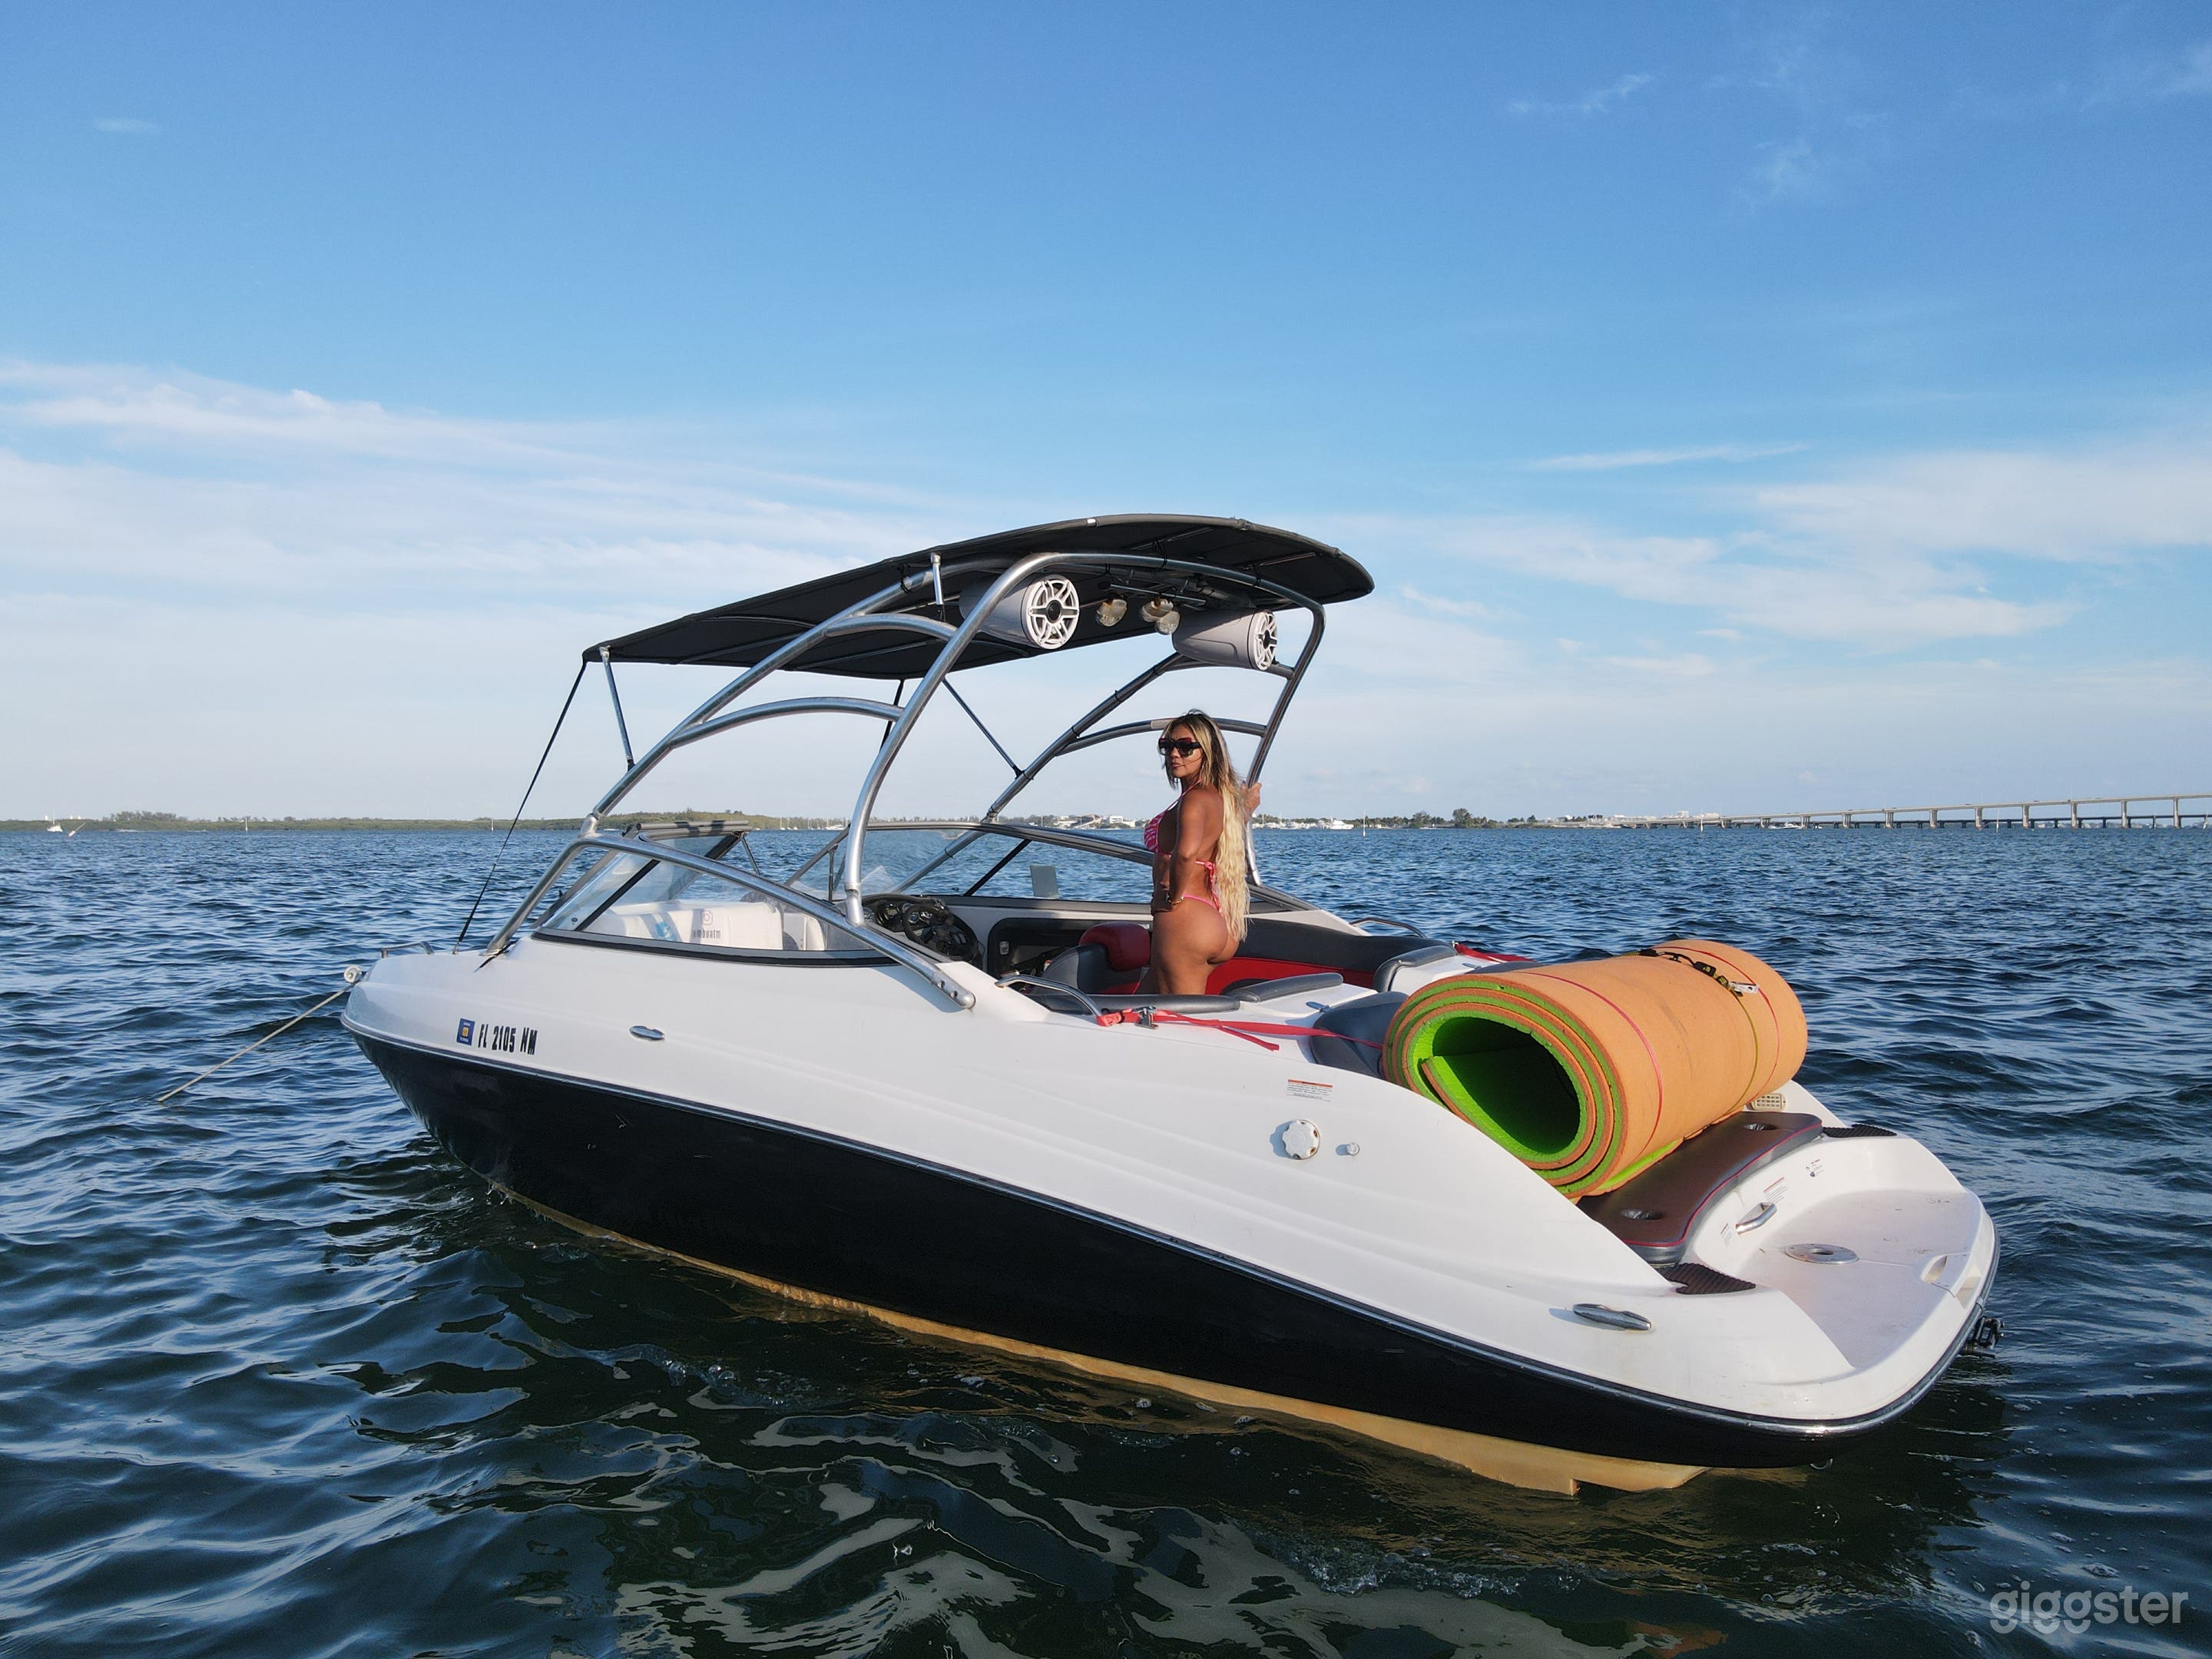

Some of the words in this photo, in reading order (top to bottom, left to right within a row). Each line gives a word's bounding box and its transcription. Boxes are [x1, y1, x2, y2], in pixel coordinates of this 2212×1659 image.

[478, 1024, 488, 1048] FL
[492, 1025, 516, 1053] 2105
[520, 1027, 538, 1055] NM
